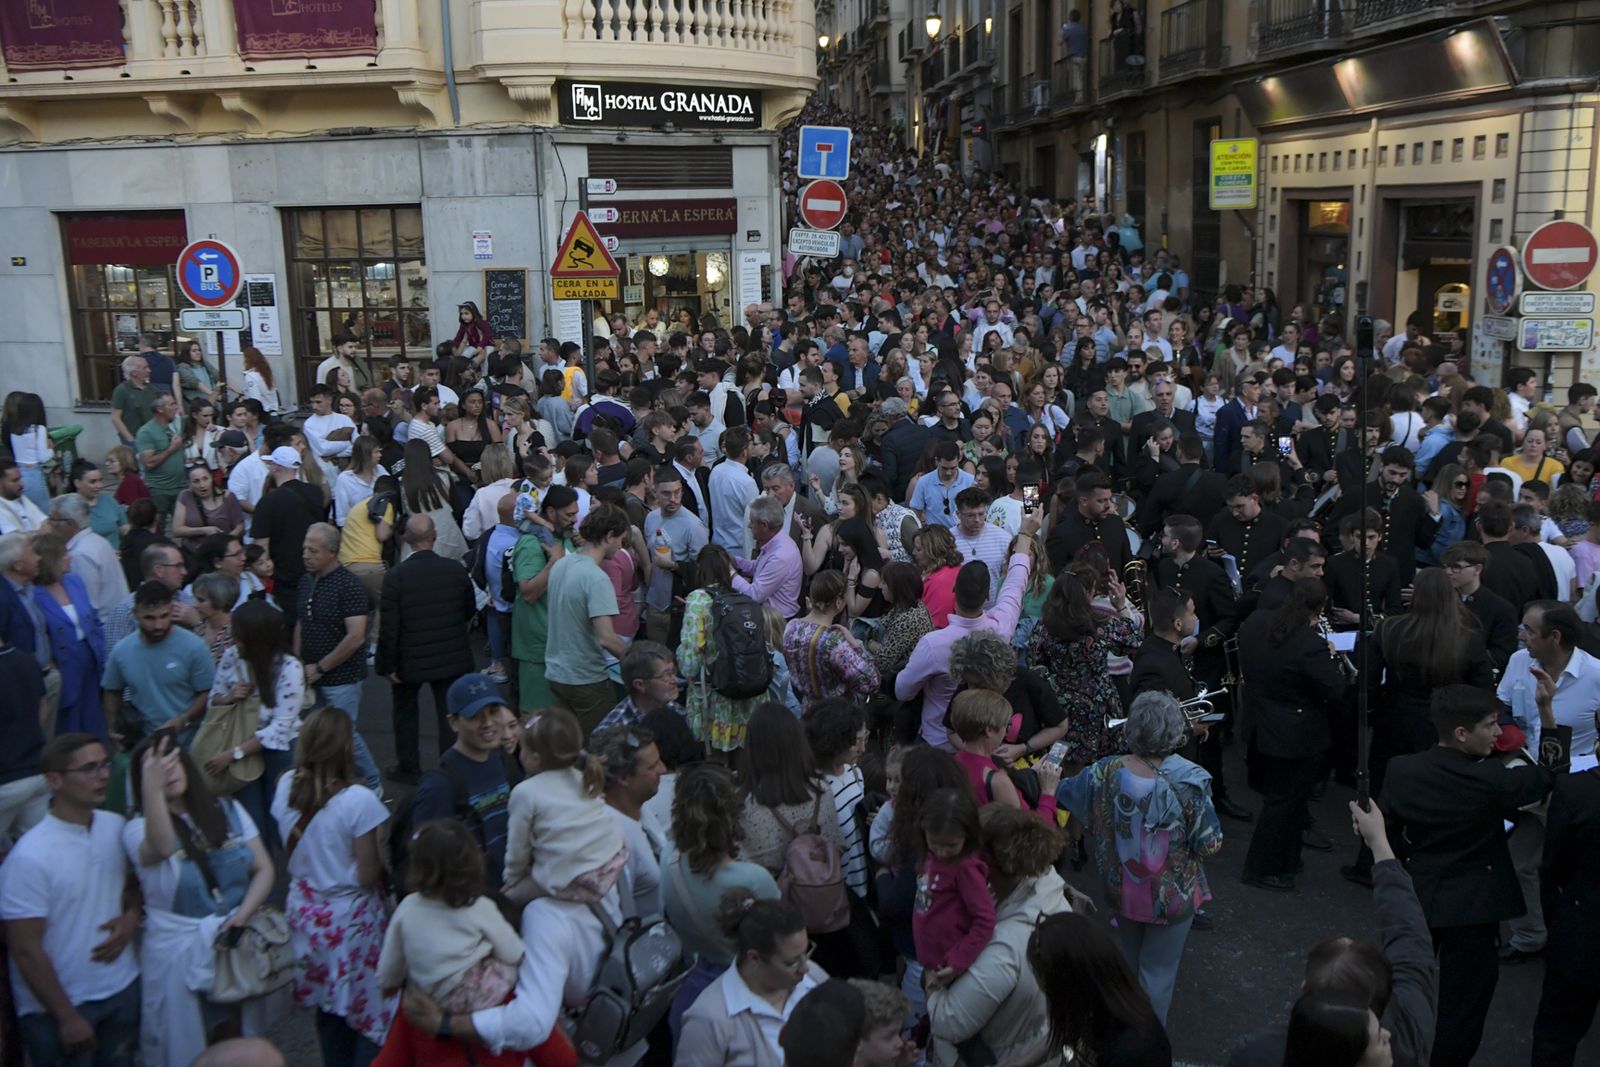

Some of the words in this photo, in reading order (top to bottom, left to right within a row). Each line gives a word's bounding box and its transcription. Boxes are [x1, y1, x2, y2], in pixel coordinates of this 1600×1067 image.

[301, 3, 343, 13] HOTELES
[605, 94, 657, 111] HOSTAL
[660, 91, 754, 114] GRANADA
[617, 209, 660, 223] BERNA
[205, 267, 214, 281] P
[200, 282, 222, 291] BUS
[556, 280, 582, 288] CERA
[586, 280, 599, 288] EN
[603, 279, 614, 287] LA
[565, 290, 607, 298] CALZADA
